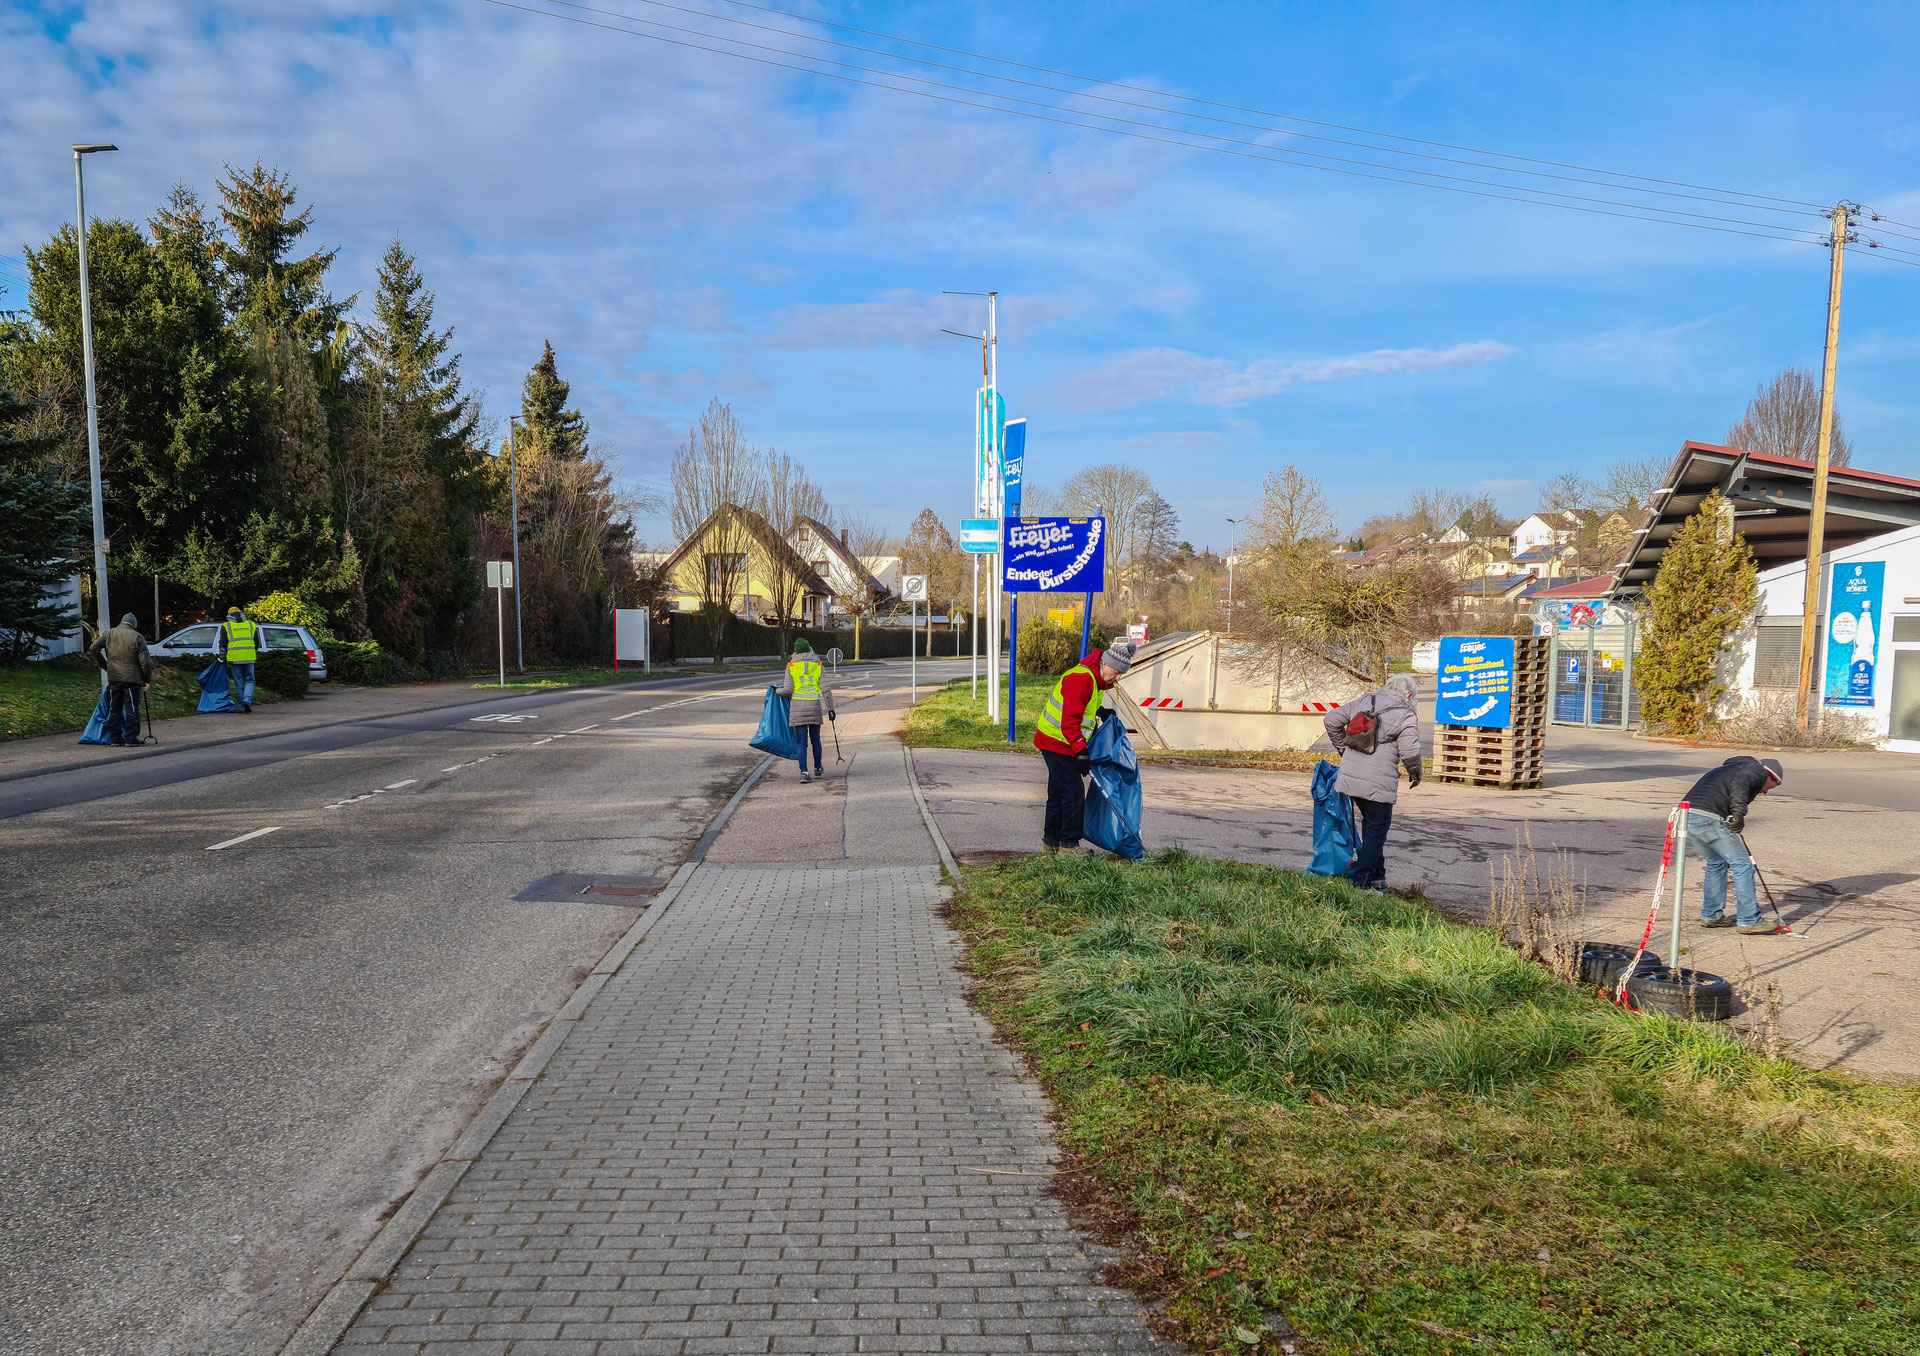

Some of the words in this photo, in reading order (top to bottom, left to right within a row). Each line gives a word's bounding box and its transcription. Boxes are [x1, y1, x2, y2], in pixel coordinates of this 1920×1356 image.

[1023, 522, 1057, 531] Getränkemarkt
[1009, 525, 1073, 550] Freyer
[1058, 543, 1075, 552] lohnt!
[1039, 519, 1102, 591] Durststrecke
[1006, 567, 1039, 580] Ende
[1039, 568, 1053, 578] der
[909, 581, 920, 590] 30
[1848, 578, 1867, 586] AQUA
[1459, 643, 1487, 654] Freyer
[1463, 656, 1484, 664] Neue
[1569, 658, 1577, 672] P
[1445, 659, 1504, 673] Öffnungszeiten!
